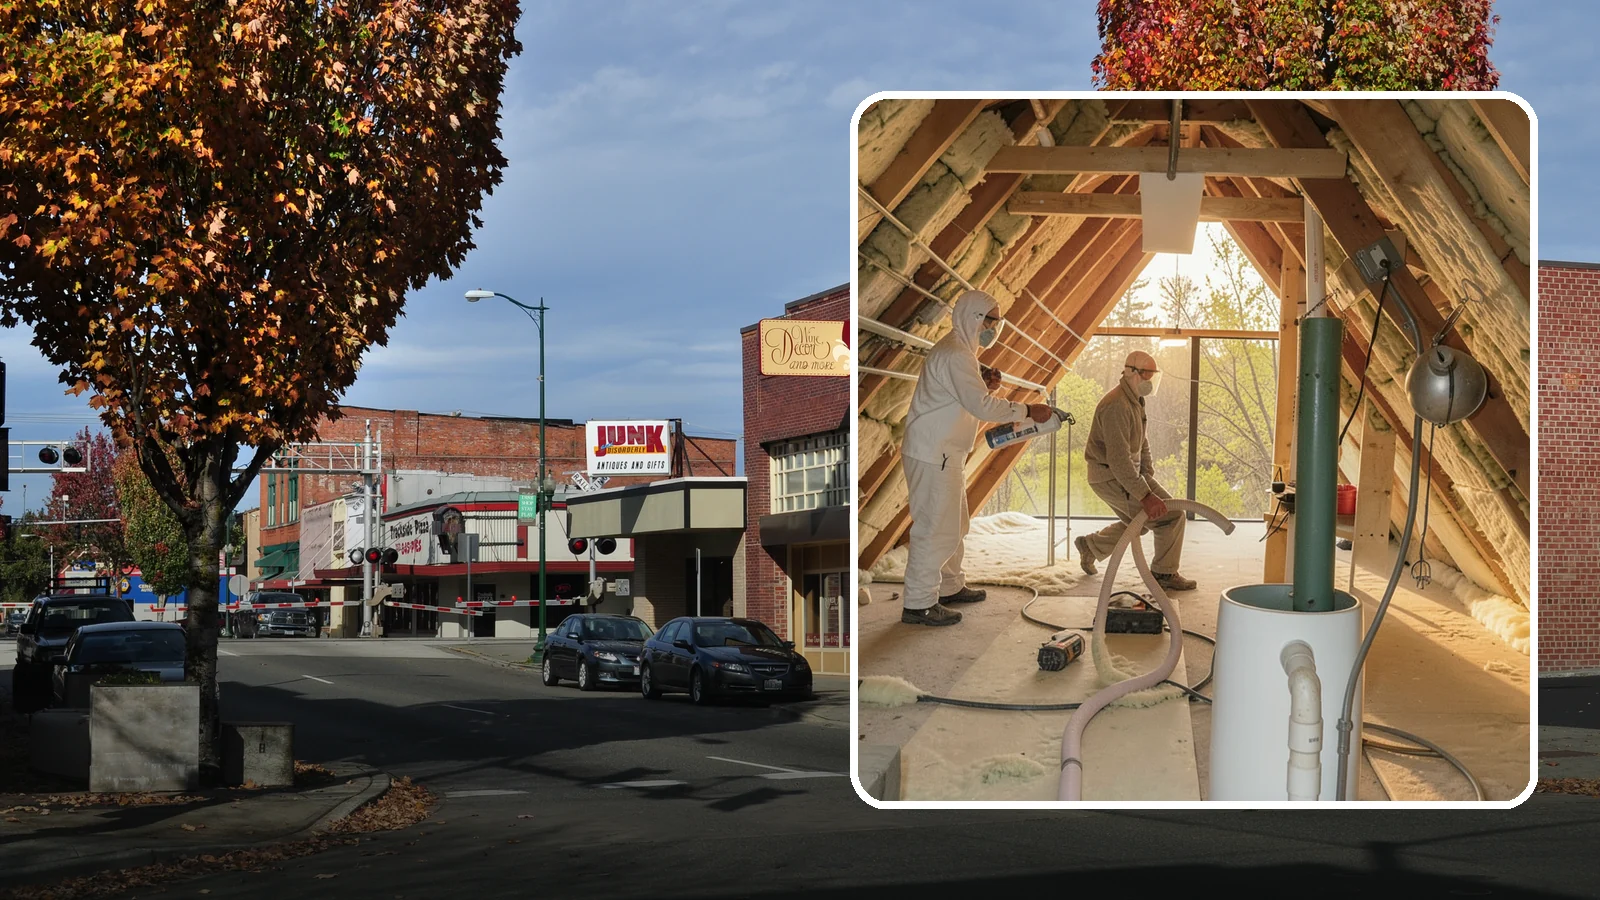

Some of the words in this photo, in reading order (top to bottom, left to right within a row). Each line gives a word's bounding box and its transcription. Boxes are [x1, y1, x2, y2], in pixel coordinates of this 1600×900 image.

[765, 328, 831, 365] Decor
[595, 425, 665, 457] JUNK
[607, 446, 646, 454] DISORDERLY
[596, 461, 628, 470] ANTIQUES
[631, 461, 644, 470] AND
[647, 460, 665, 470] GIFTS
[415, 519, 429, 534] Pizza
